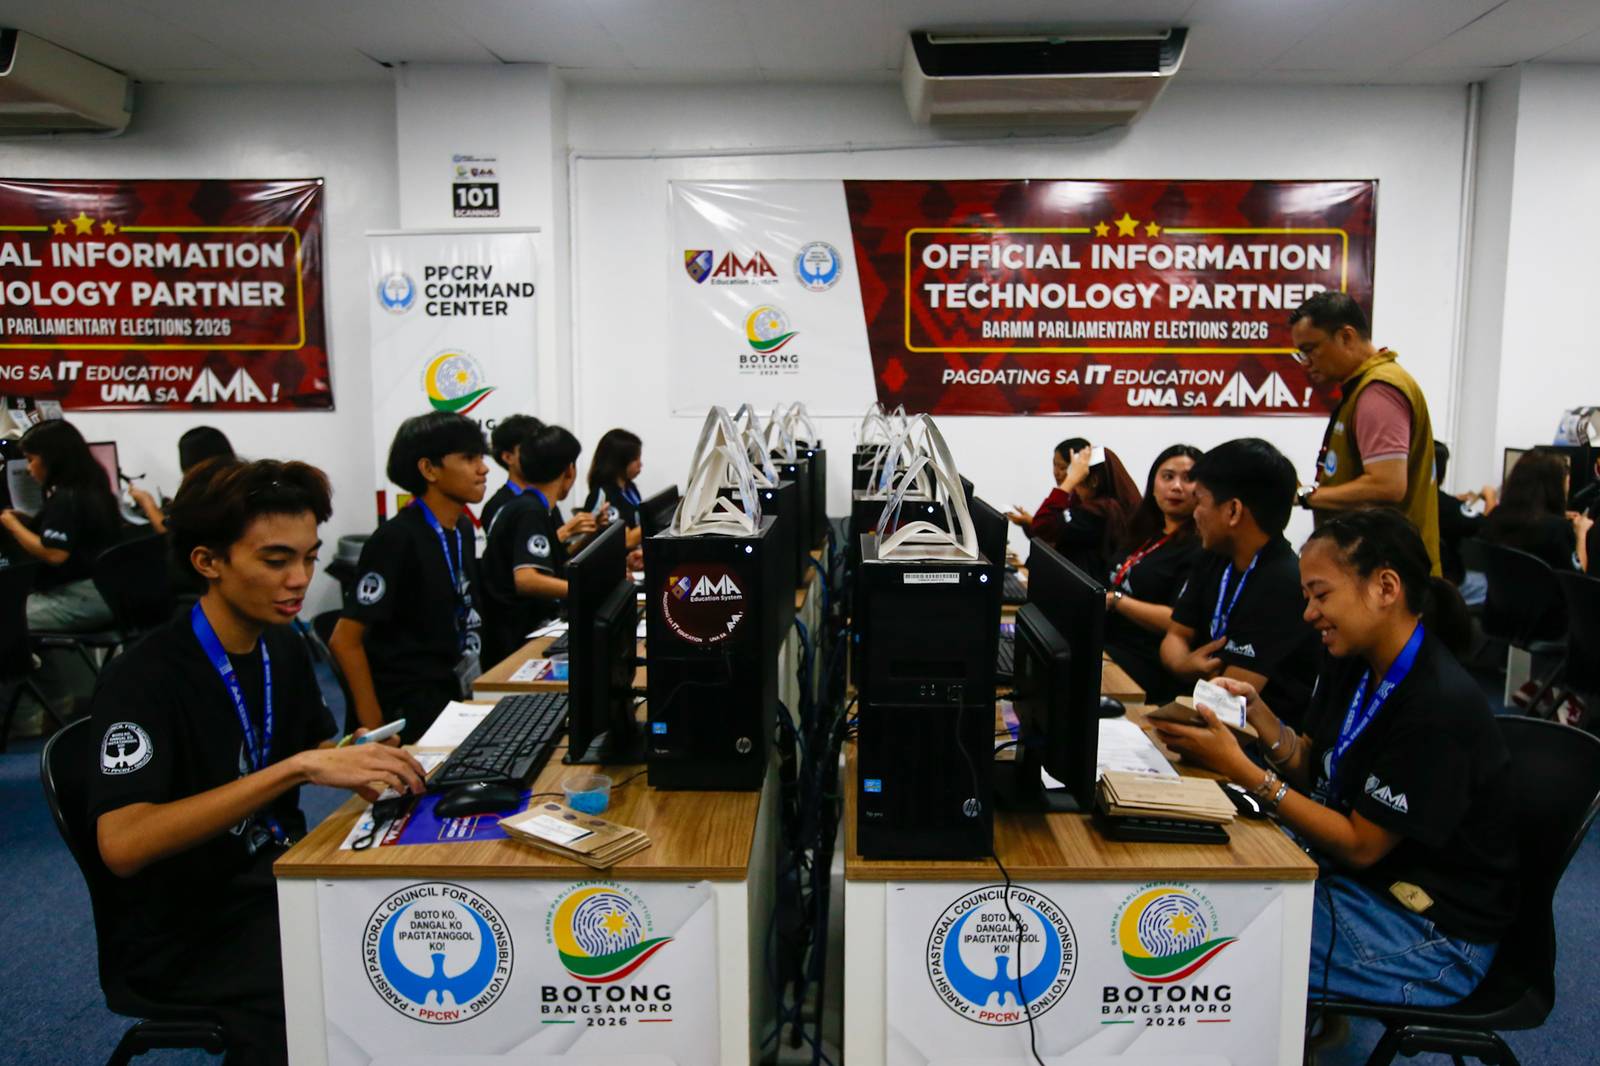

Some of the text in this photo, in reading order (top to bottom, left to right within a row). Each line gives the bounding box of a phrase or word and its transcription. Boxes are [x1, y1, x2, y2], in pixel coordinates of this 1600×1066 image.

[457, 188, 494, 207] 101
[52, 242, 285, 268] INFORMATION
[712, 250, 778, 277] AMA
[922, 243, 1330, 270] OFFICIAL INFORMATION
[425, 265, 492, 280] PPCRV
[0, 280, 286, 307] OLOGY PARTNER
[425, 282, 534, 298] COMMAND
[924, 283, 1160, 309] TECHNOLOGY
[426, 301, 508, 316] CENTER
[8, 317, 117, 336] PARLIAMENTARY
[121, 318, 192, 336] ELECTIONS
[195, 318, 231, 336] 2026
[982, 321, 1269, 340] BARMM PARLIAMENTARY ELECTIONS 2026
[740, 355, 798, 364] BOTONG
[28, 365, 52, 380] SA
[58, 360, 83, 380] IT
[86, 365, 192, 381] EDUCATION
[942, 364, 1224, 386] PAGDATING SA IT EDUCATION
[100, 384, 150, 402] UNA
[155, 387, 178, 402] SA
[1127, 388, 1178, 407] UNA
[1183, 392, 1208, 407] SA
[690, 574, 742, 596] AMA
[672, 622, 680, 630] IT
[1371, 785, 1408, 810] AMA
[414, 910, 440, 920] BOTO
[624, 888, 654, 932] ELECTIONS
[981, 914, 1006, 922] BOTO
[1192, 888, 1218, 932] ELECTIONS
[410, 921, 462, 930] DANGAL KO
[976, 924, 1013, 932] DANGAL
[399, 932, 474, 940] IPAGTATANGGOL
[366, 887, 509, 1012] PARISH PASTORAL COUNCIL FOR RESPONSIBLE VOTING
[430, 942, 446, 950] KO!
[931, 890, 1072, 1014] PARISH PASTORAL COUNCIL FOR RESPONSIBLE VOTING
[994, 945, 1010, 954] KO!
[541, 984, 671, 1002] BOTONG
[1103, 985, 1231, 1003] BOTONG
[419, 1008, 460, 1020] PPCRV
[541, 1004, 672, 1014] BANGSAMORO
[979, 1010, 1020, 1022] PPCRV
[1102, 1004, 1231, 1014] BANGSAMORO
[586, 1018, 628, 1026] 2026
[1146, 1018, 1186, 1026] 2026
